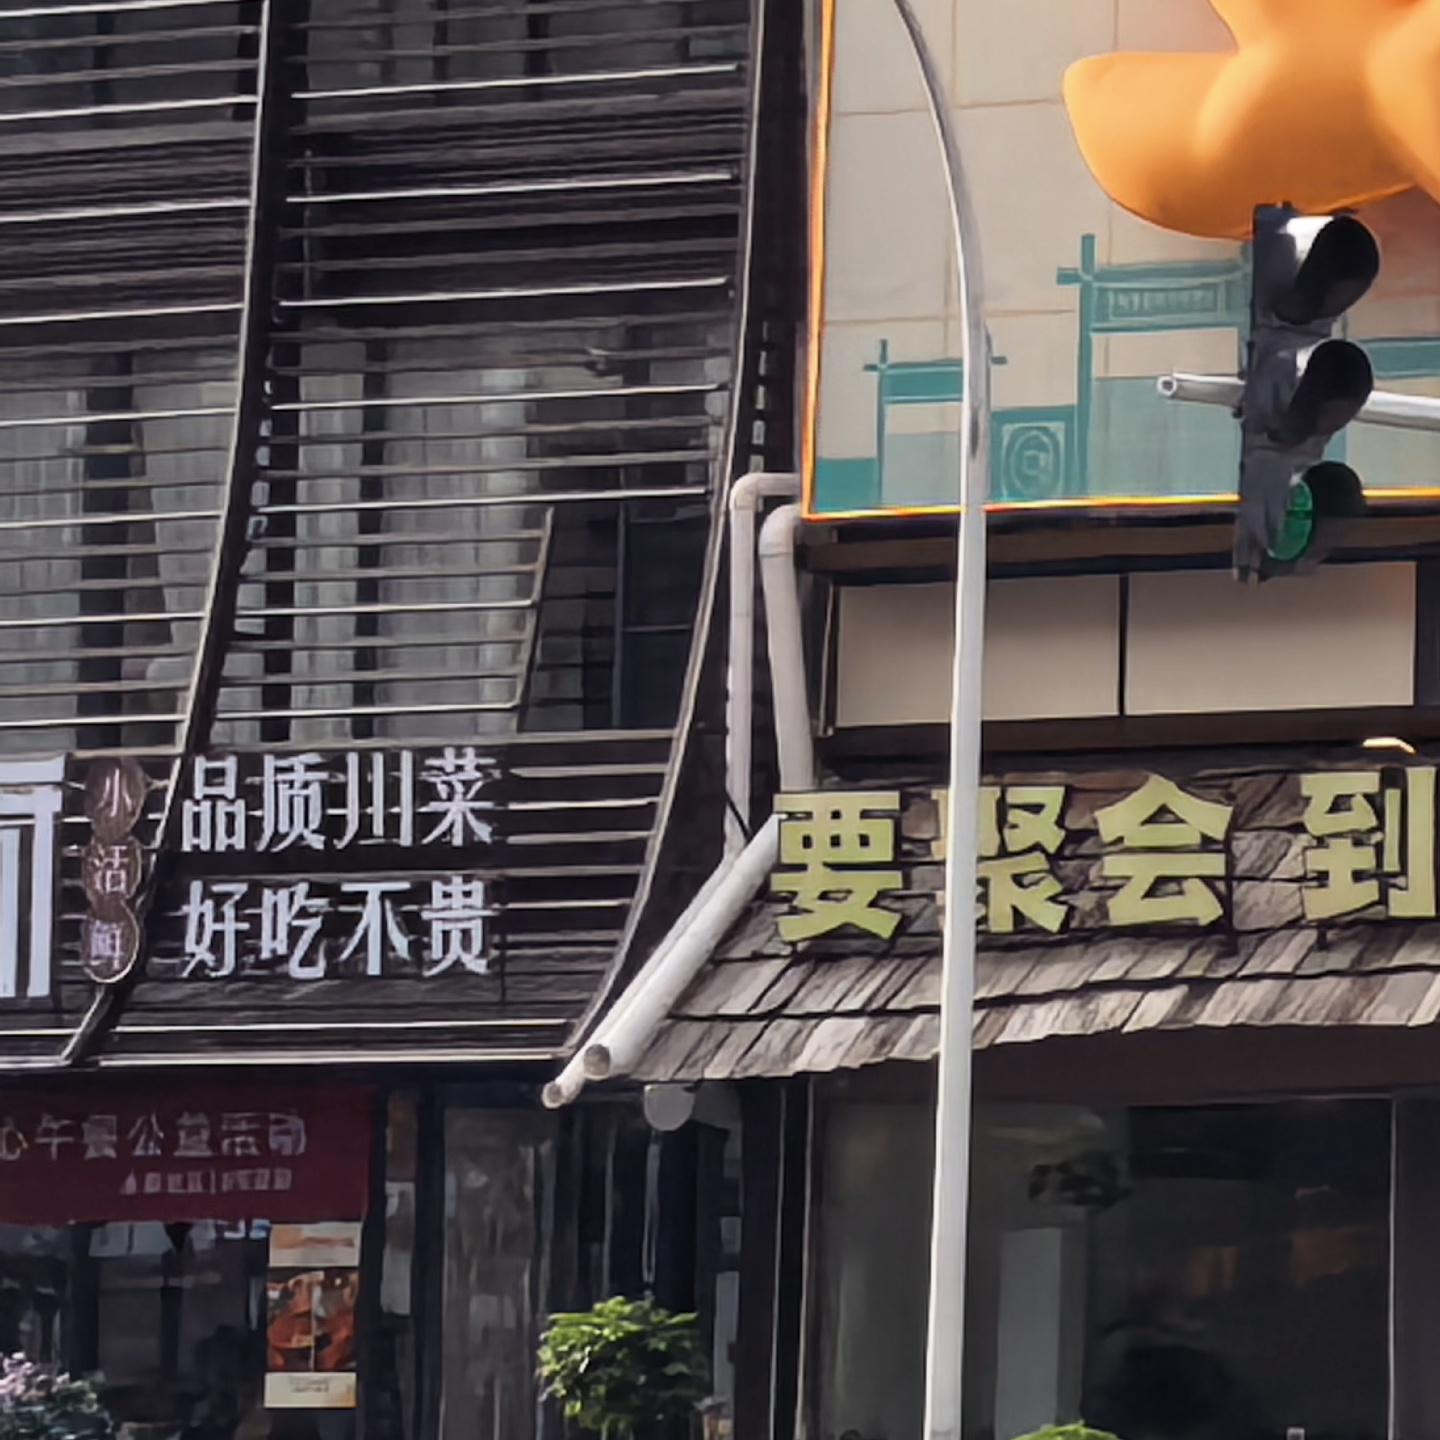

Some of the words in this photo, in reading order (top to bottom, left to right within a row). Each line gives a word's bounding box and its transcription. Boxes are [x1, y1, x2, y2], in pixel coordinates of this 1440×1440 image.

[181, 747, 499, 853] 品质川菜
[181, 876, 499, 981] 好吃不贵
